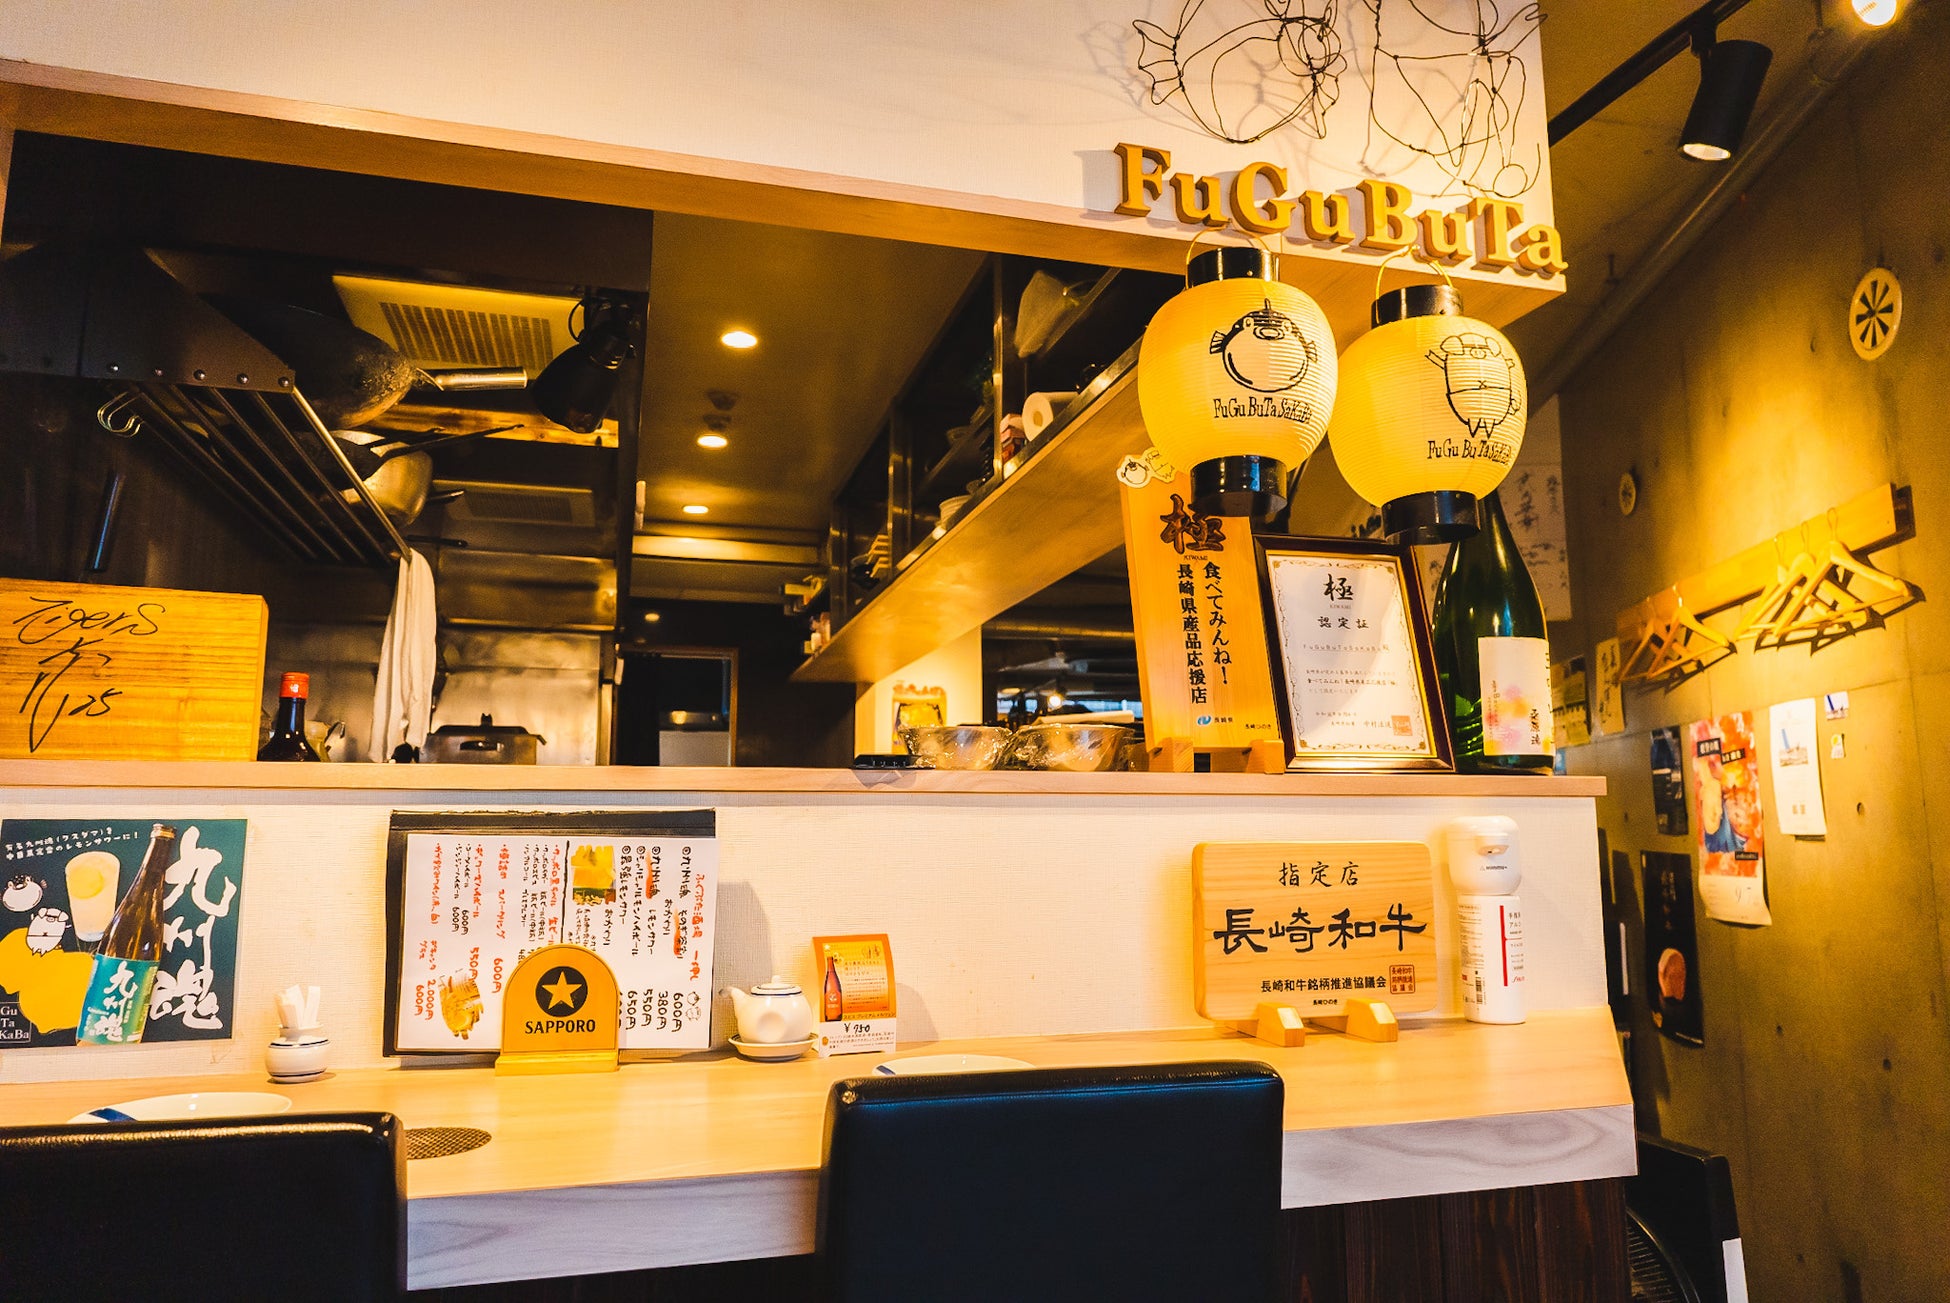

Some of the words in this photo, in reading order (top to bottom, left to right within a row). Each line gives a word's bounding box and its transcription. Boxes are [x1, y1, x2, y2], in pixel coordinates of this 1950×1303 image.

[1114, 142, 1568, 276] FuGuBuTa
[1323, 573, 1354, 601] 極
[1177, 563, 1207, 704] 長崎県産品応援店
[1317, 616, 1369, 629] 認定証
[1278, 861, 1360, 887] 指定店
[452, 906, 460, 933] 600円
[461, 909, 469, 935] 600円
[1213, 903, 1428, 955] 長崎和牛
[491, 957, 503, 993] 600円
[1261, 975, 1387, 993] 長崎和牛銘柄推進協議会
[414, 985, 424, 1016] 600円
[625, 990, 638, 1030] 650円
[641, 989, 653, 1027] 550円
[656, 991, 668, 1030] 380円
[671, 992, 684, 1032] 600円
[525, 1020, 595, 1034] SAPPORO
